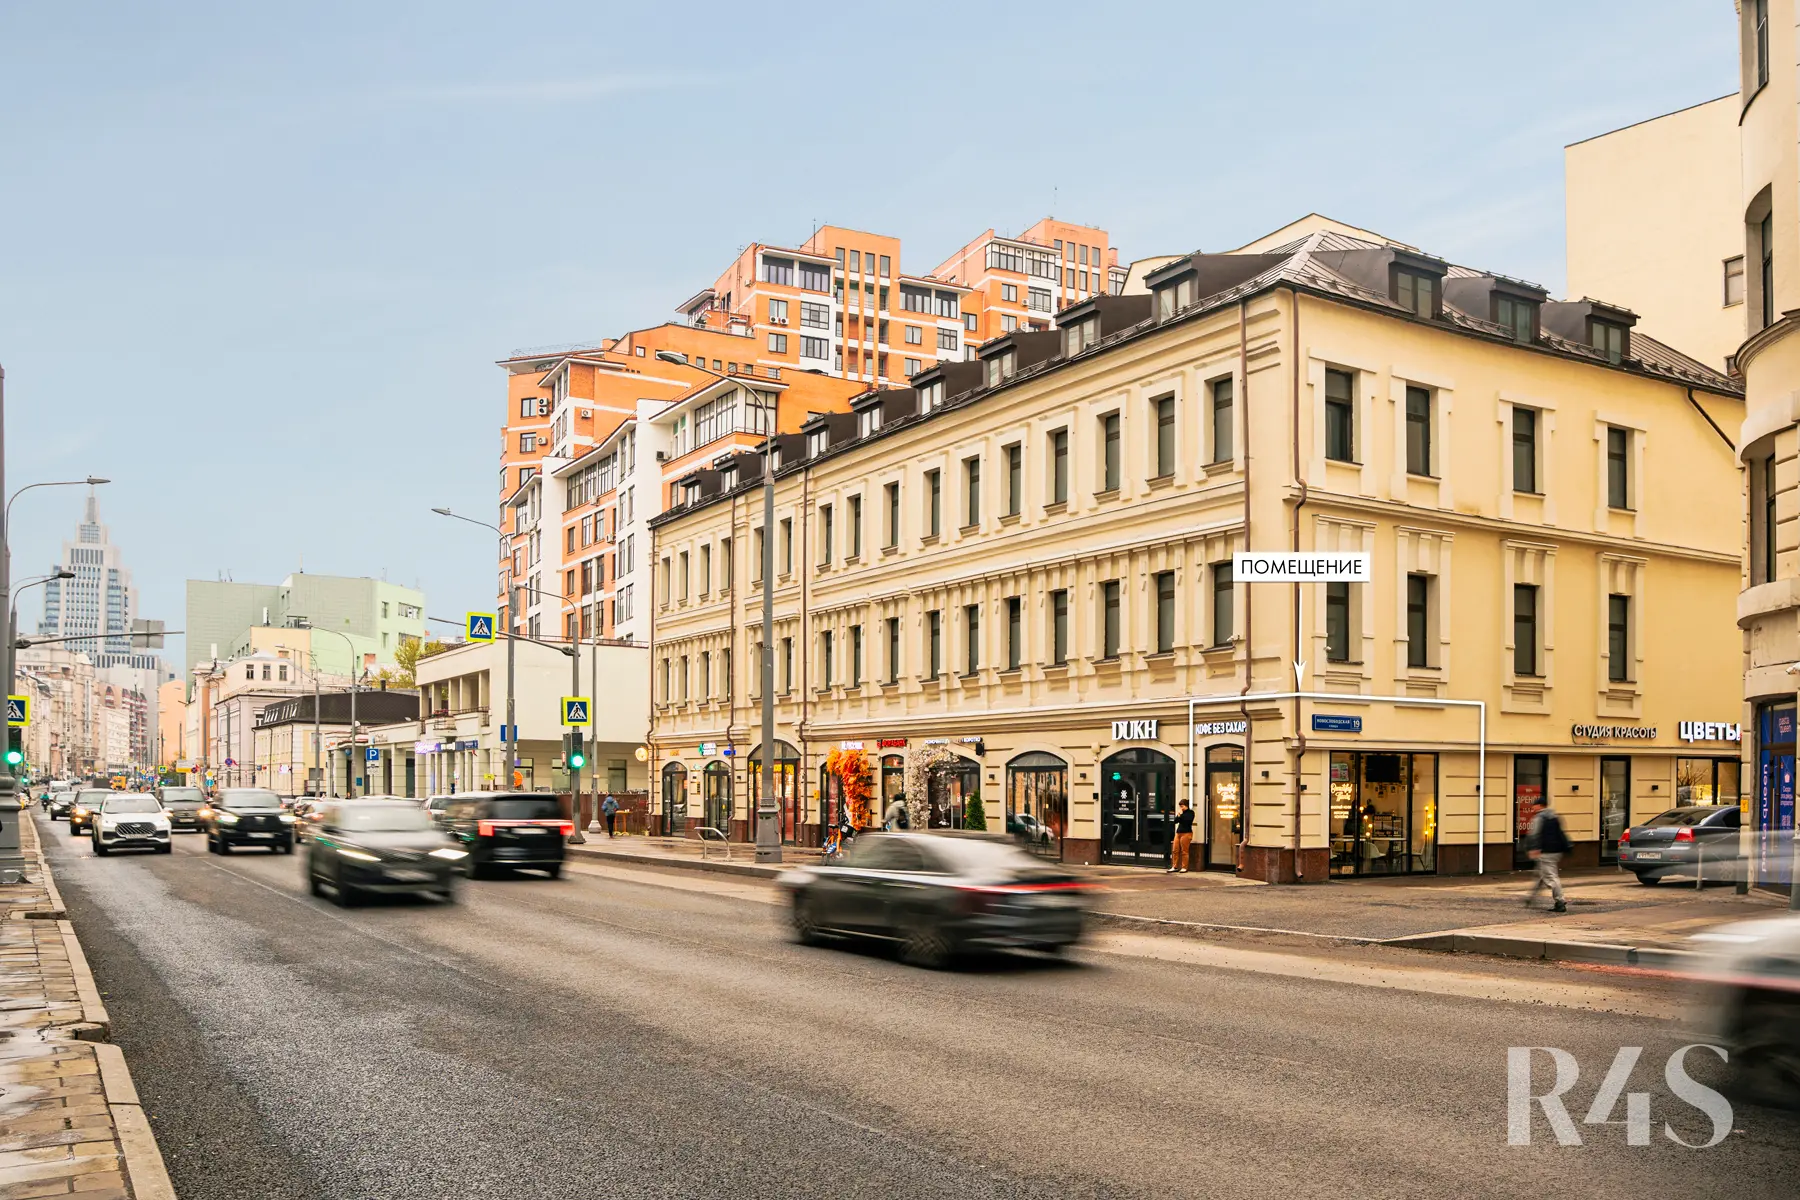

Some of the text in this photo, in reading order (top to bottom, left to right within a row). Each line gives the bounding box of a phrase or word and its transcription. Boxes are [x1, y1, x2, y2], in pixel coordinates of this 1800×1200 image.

[1111, 719, 1158, 740] DUKH
[1196, 721, 1247, 734] КОФЕ БЕЗ САХАР
[1353, 719, 1360, 728] 19
[1573, 724, 1658, 738] СТУДИЯ КРАСОТЫ
[1679, 721, 1741, 743] ЦВЕТЫ
